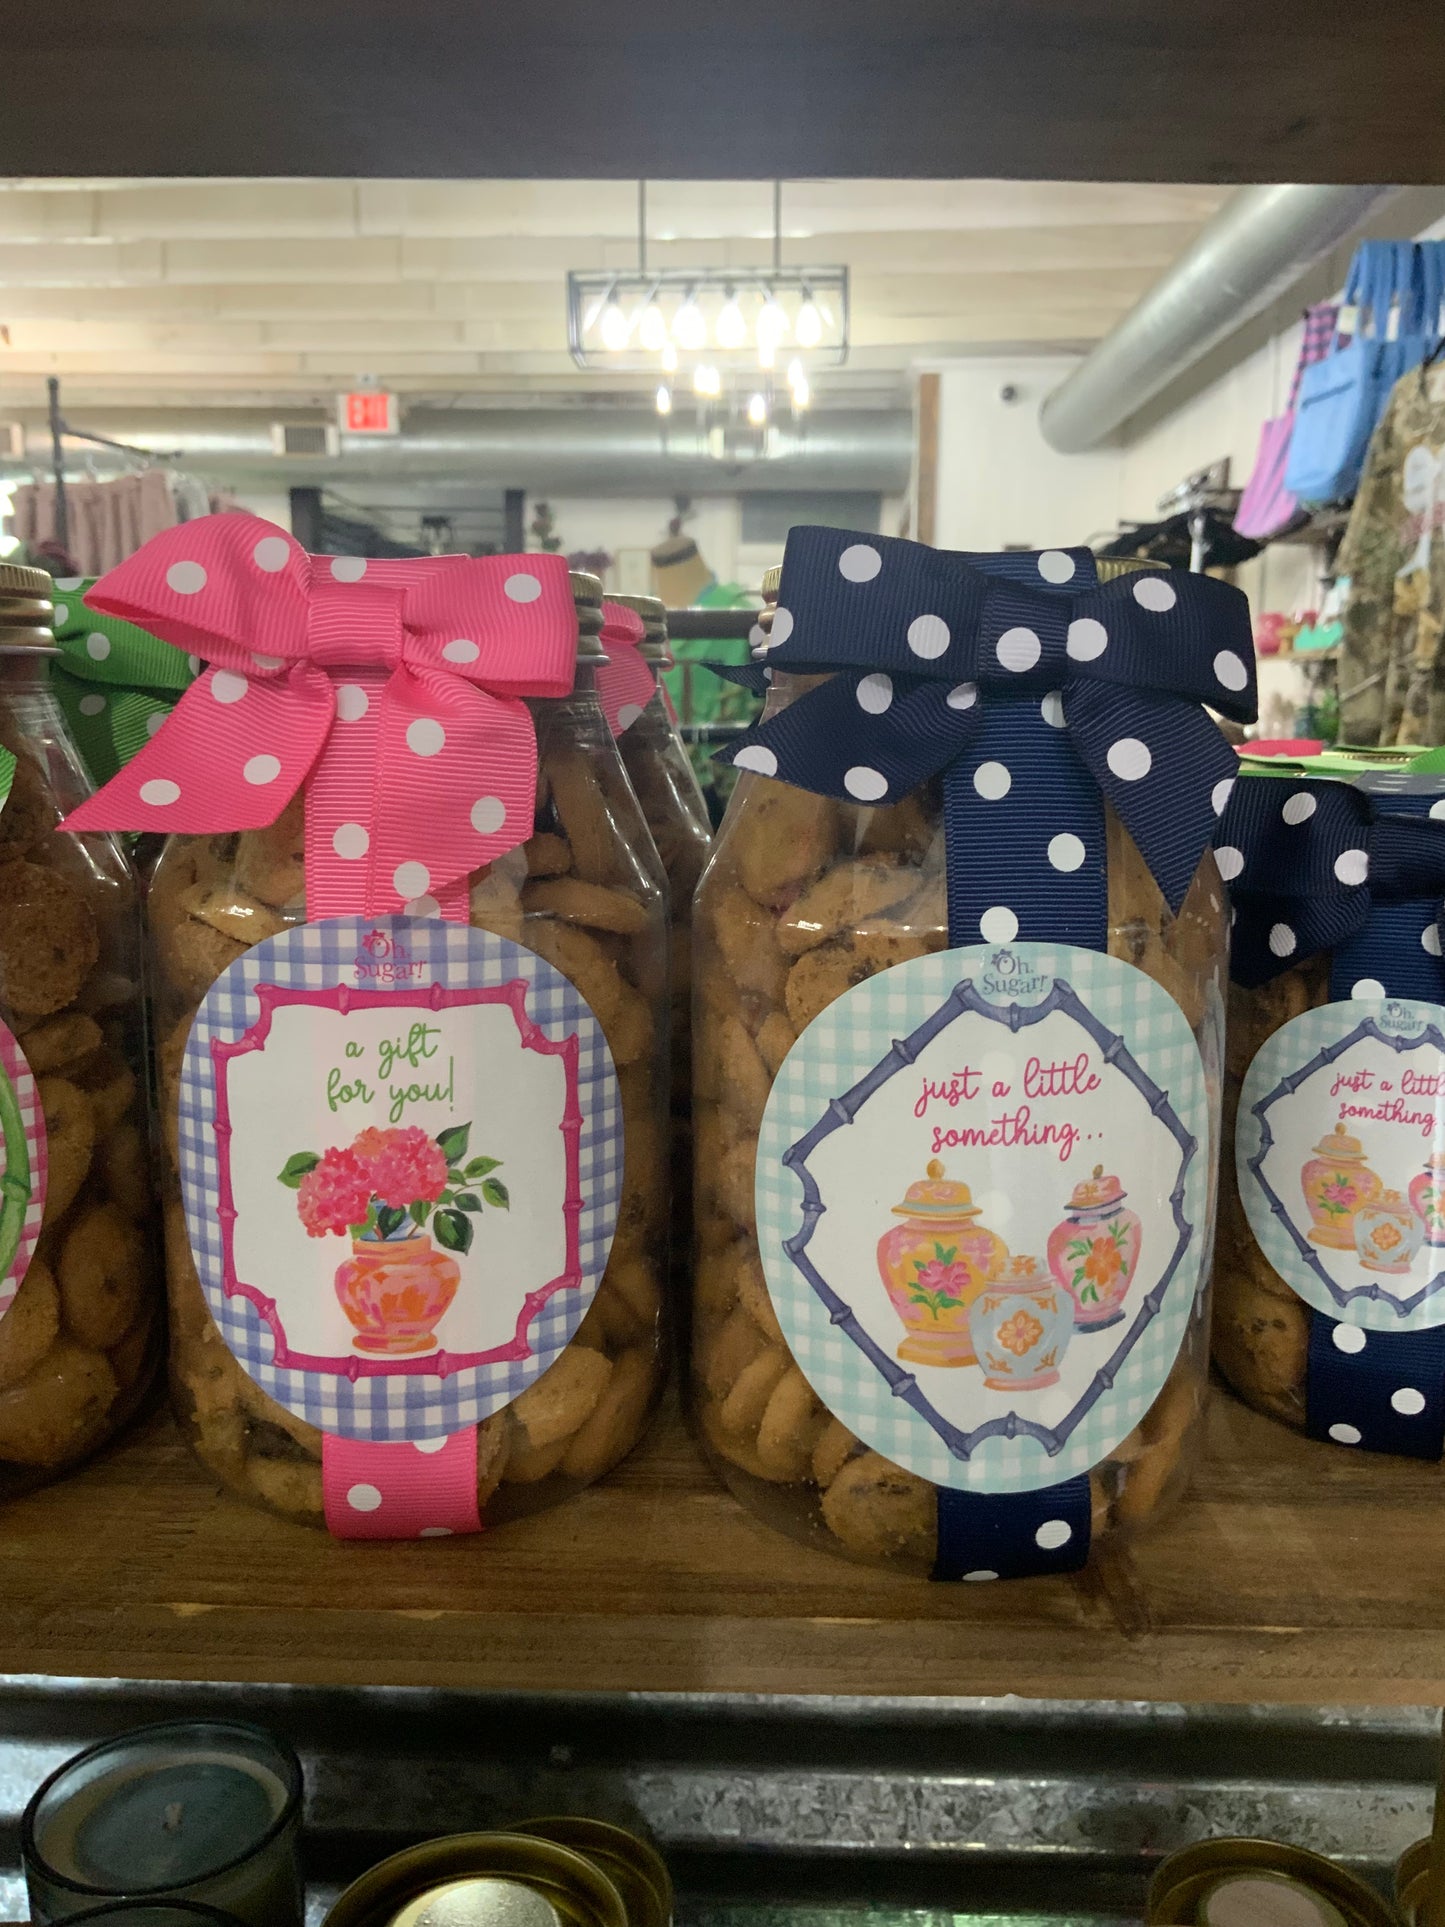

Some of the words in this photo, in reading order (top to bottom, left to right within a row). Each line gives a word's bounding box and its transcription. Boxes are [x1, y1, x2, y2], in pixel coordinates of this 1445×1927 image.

[347, 393, 388, 430] EXIT
[354, 955, 428, 983] Sugar!
[982, 973, 1048, 997] Sugar!
[345, 1041, 365, 1058] a
[378, 1022, 442, 1080] gift
[327, 1067, 376, 1112] for
[388, 1055, 454, 1124] you!
[914, 1065, 983, 1118] just
[991, 1080, 1011, 1098] a
[1023, 1052, 1102, 1099] little
[1329, 1068, 1376, 1097] just
[1380, 1080, 1393, 1092] a
[1401, 1068, 1445, 1097] littl
[931, 1104, 1103, 1162] something...
